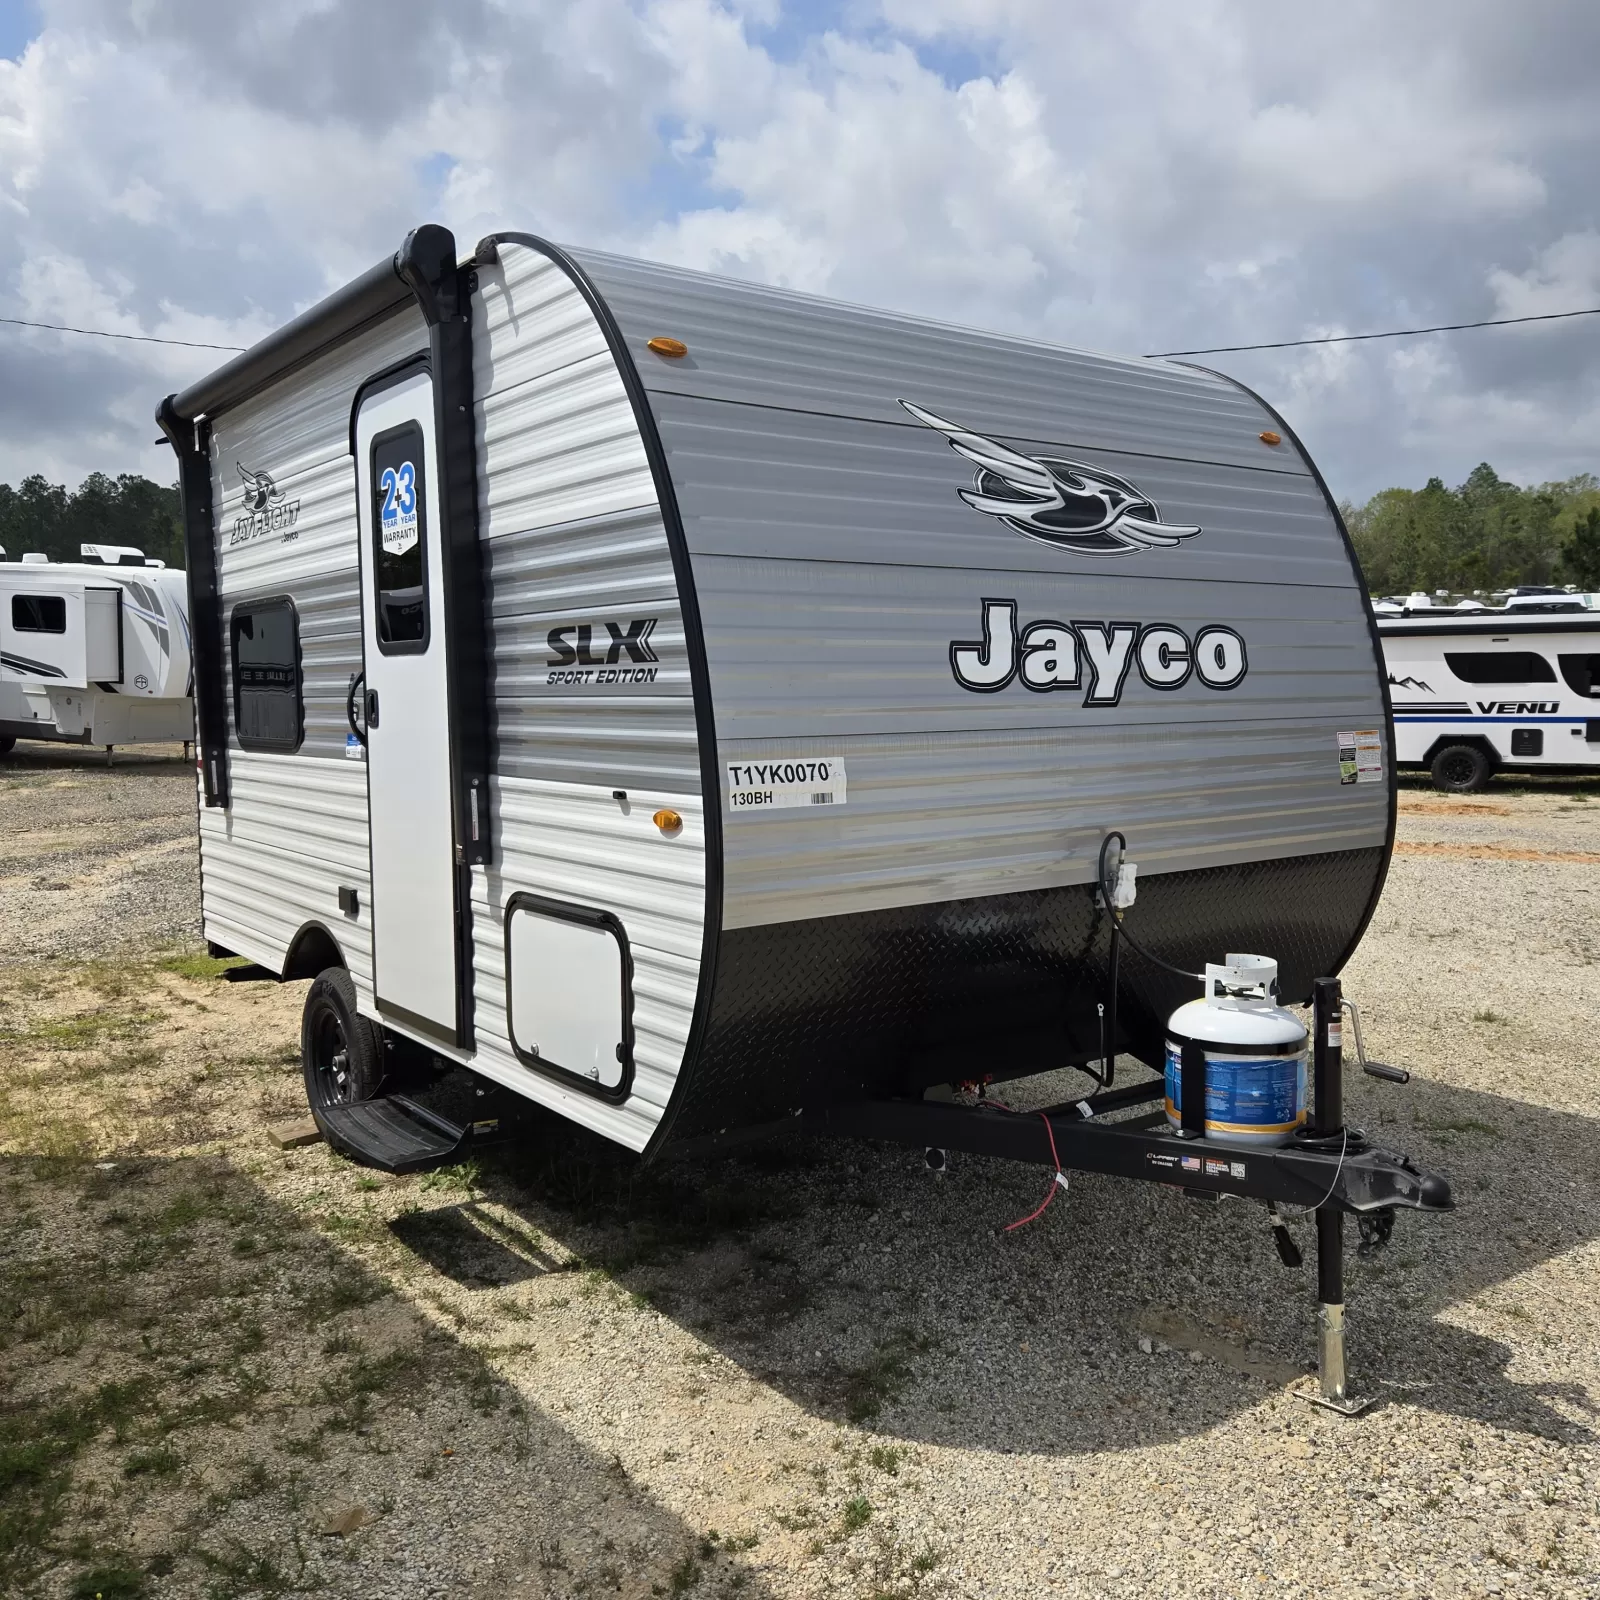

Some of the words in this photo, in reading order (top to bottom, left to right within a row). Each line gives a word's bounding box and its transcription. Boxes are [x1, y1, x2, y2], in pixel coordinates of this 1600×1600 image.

[383, 518, 398, 529] YEAR
[401, 513, 416, 525] YEAR
[383, 527, 416, 544] WARRANTY
[546, 618, 659, 667] SLX
[950, 597, 1248, 708] Jayco
[546, 670, 594, 685] SPORT
[595, 667, 659, 684] EDITION
[1476, 700, 1561, 715] VENU
[729, 762, 829, 786] T1YK0070
[731, 790, 773, 806] 130BH
